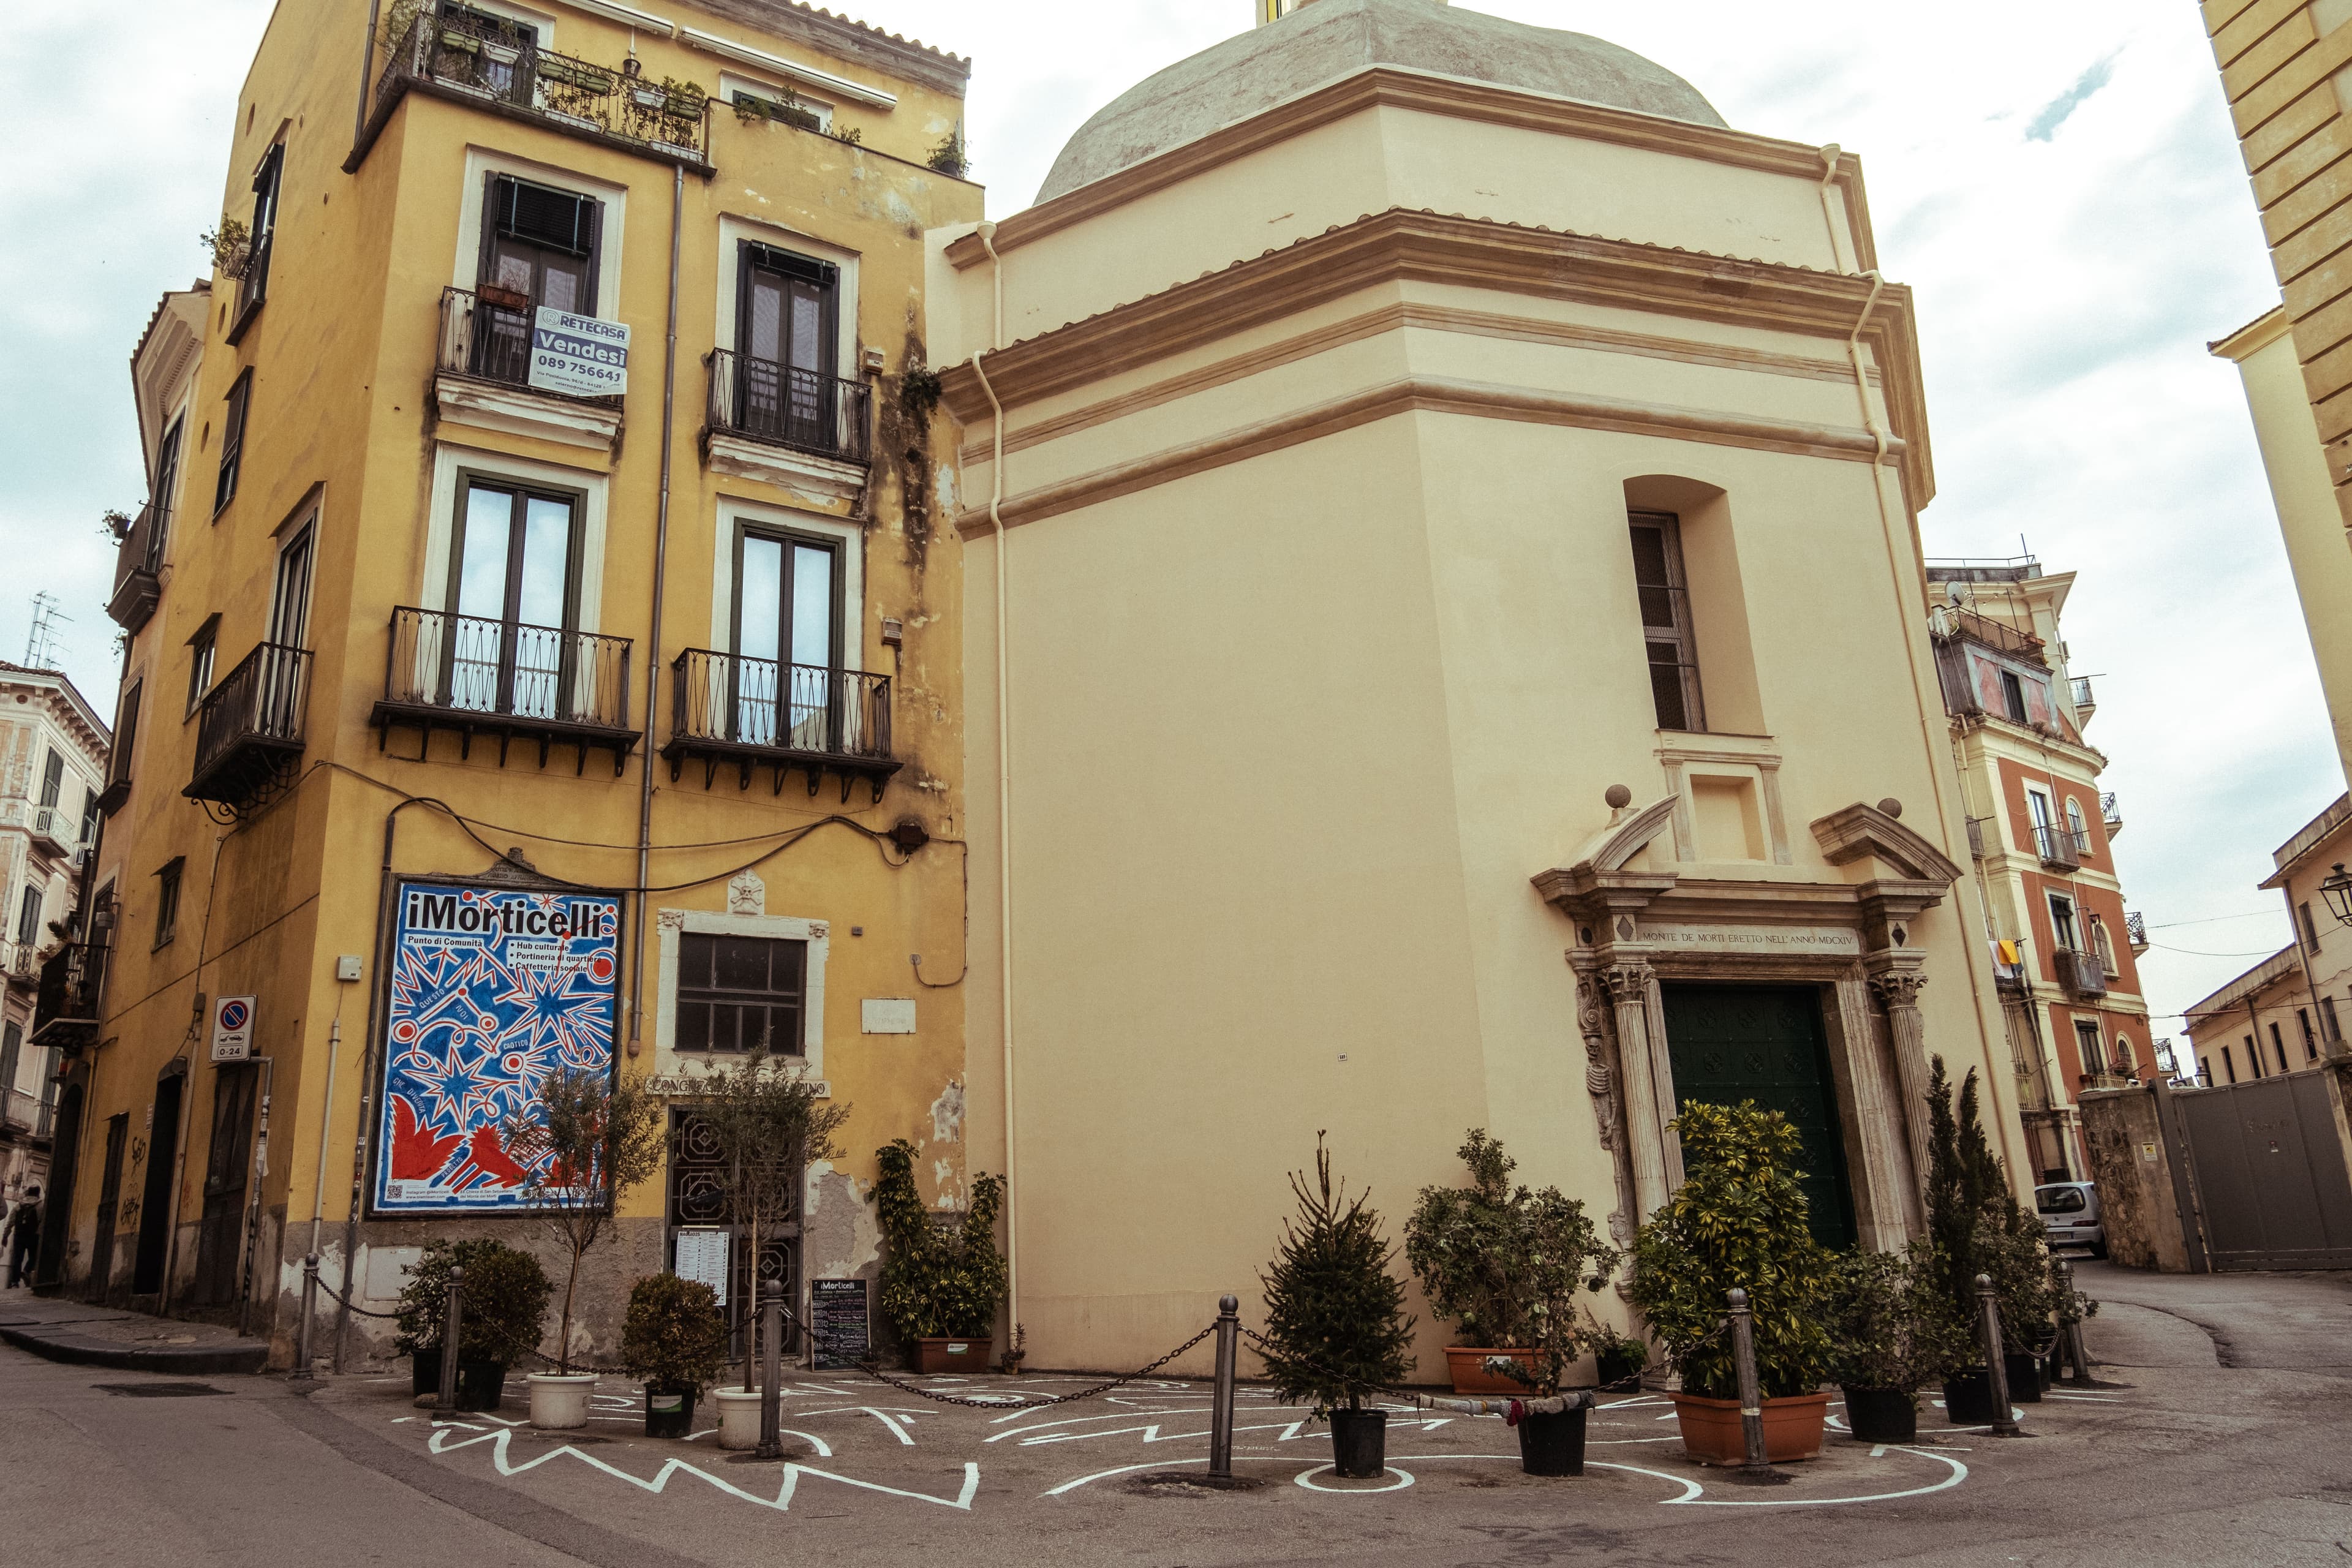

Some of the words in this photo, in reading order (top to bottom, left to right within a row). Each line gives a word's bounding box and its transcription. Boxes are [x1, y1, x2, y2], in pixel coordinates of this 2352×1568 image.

[560, 315, 626, 341] RETECASA
[539, 331, 625, 366] Vendesi
[538, 355, 566, 369] 089
[570, 362, 620, 382] 756641
[408, 893, 601, 938] iMorticelli
[444, 938, 482, 946] Comunità
[1643, 931, 1677, 941] MONTE
[1681, 932, 1694, 941] DE
[1698, 933, 1725, 943] MORTI
[1728, 934, 1762, 943] ERETTO
[1819, 935, 1852, 945] MDCXIV
[516, 952, 556, 961] Portineria
[516, 962, 557, 971] Caffetteria
[419, 989, 445, 1008] QUESTO
[455, 1005, 469, 1020] NOI
[503, 1039, 529, 1050] CAOTICO
[393, 1077, 405, 1088] CHE
[407, 1088, 426, 1114] DIVENTA
[441, 1157, 463, 1178] PROGETTO
